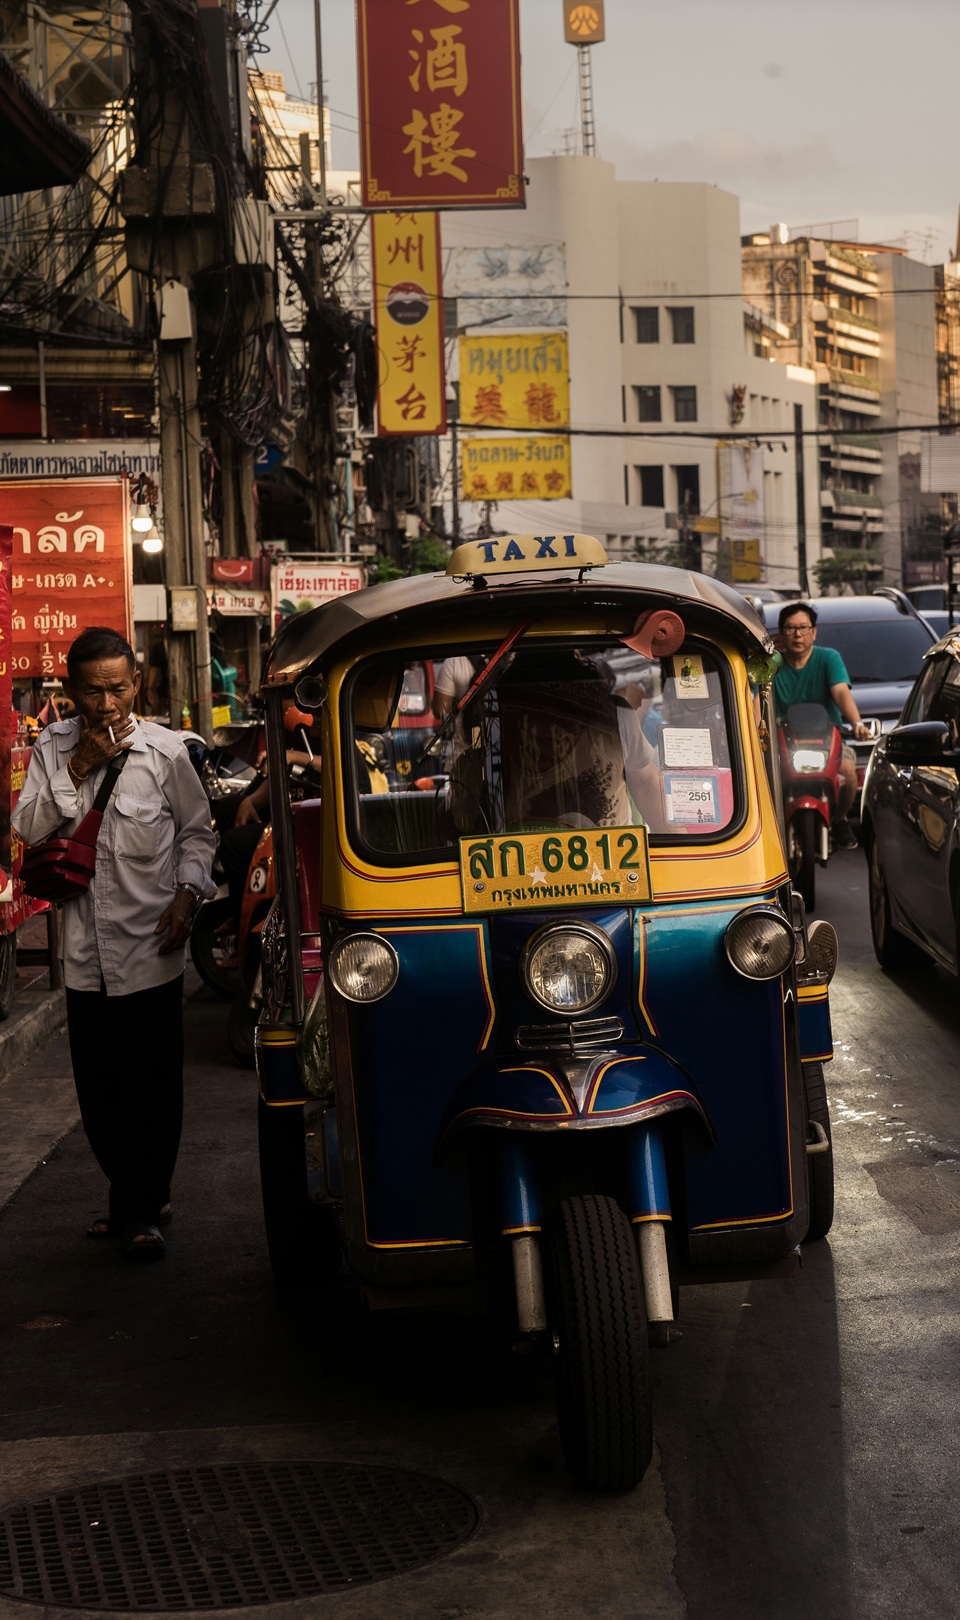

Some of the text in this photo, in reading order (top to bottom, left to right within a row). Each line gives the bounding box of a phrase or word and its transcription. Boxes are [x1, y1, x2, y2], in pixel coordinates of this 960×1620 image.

[392, 334, 427, 421] 茅台
[477, 535, 577, 562] TAXI
[688, 792, 711, 802] 2561
[468, 832, 640, 879] สก 6812
[491, 880, 621, 906] กรุงเทพมหานคร
